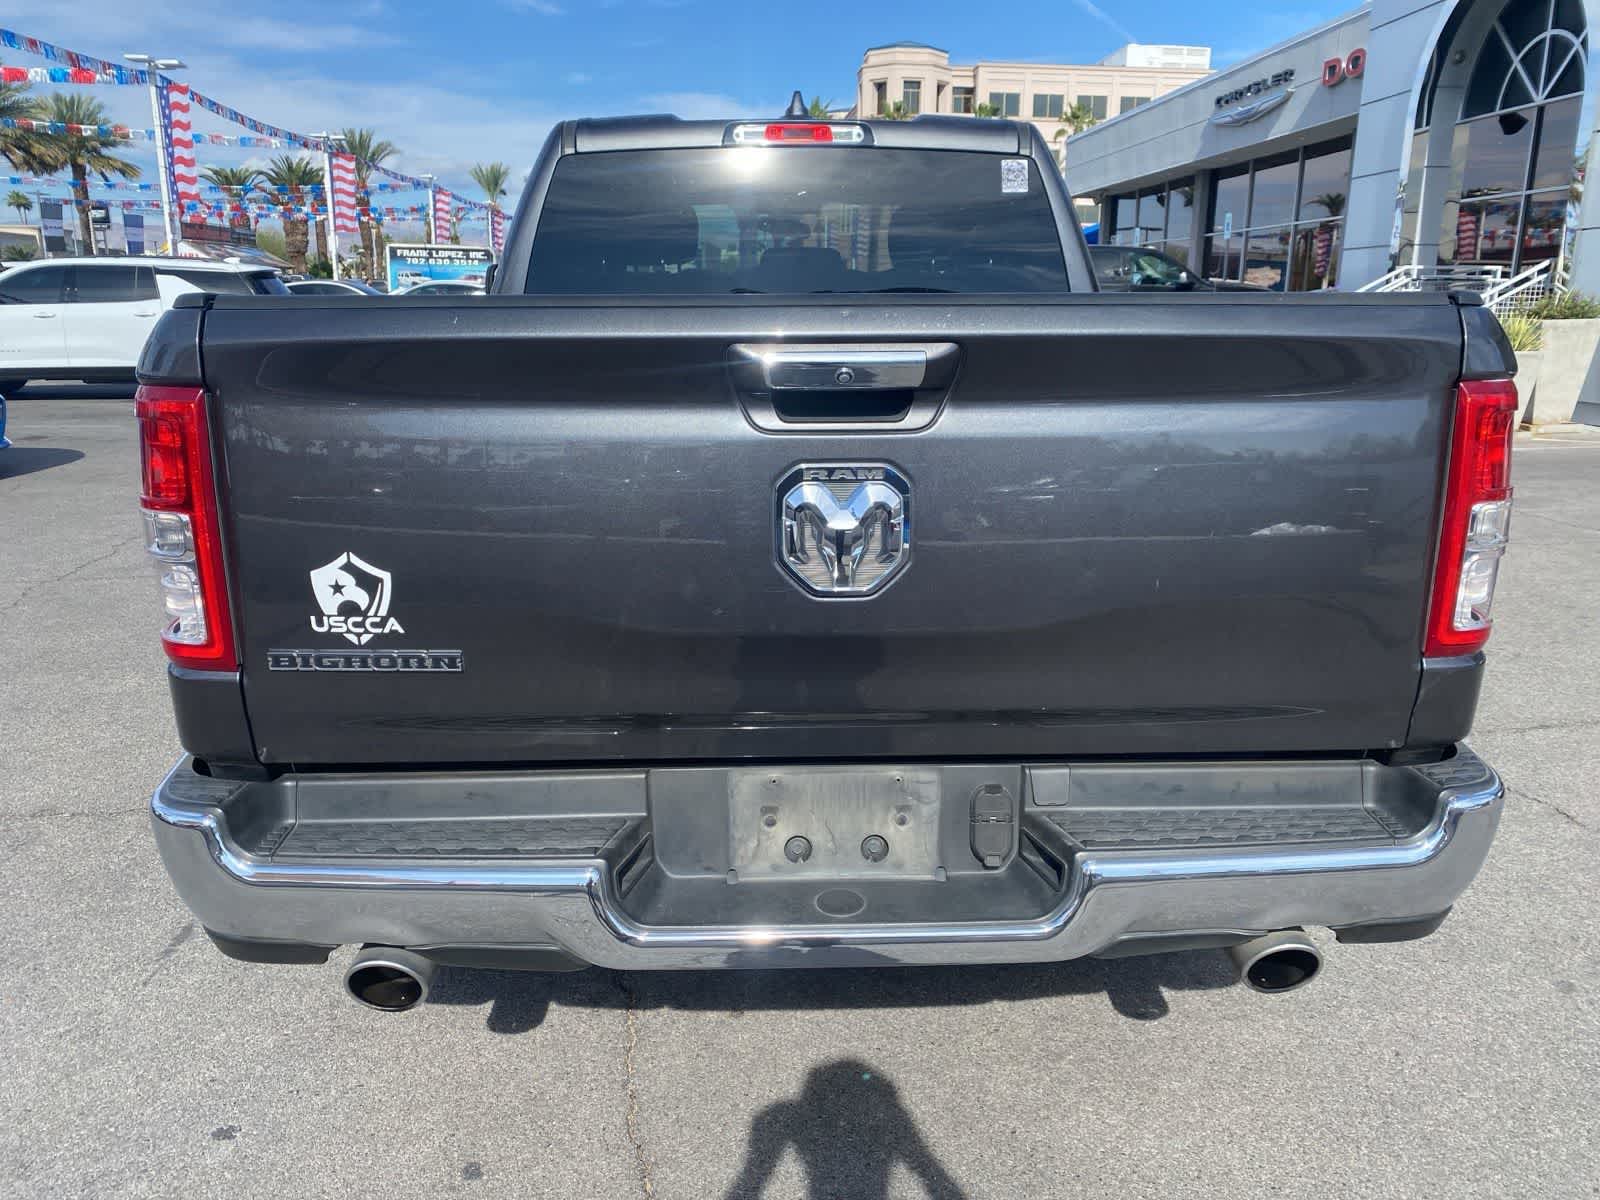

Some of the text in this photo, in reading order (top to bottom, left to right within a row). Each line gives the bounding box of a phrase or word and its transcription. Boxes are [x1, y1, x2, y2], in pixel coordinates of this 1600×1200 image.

[396, 248, 429, 257] FRANK
[469, 251, 488, 259] INC.
[802, 469, 884, 480] RAM
[309, 615, 405, 634] USCCA
